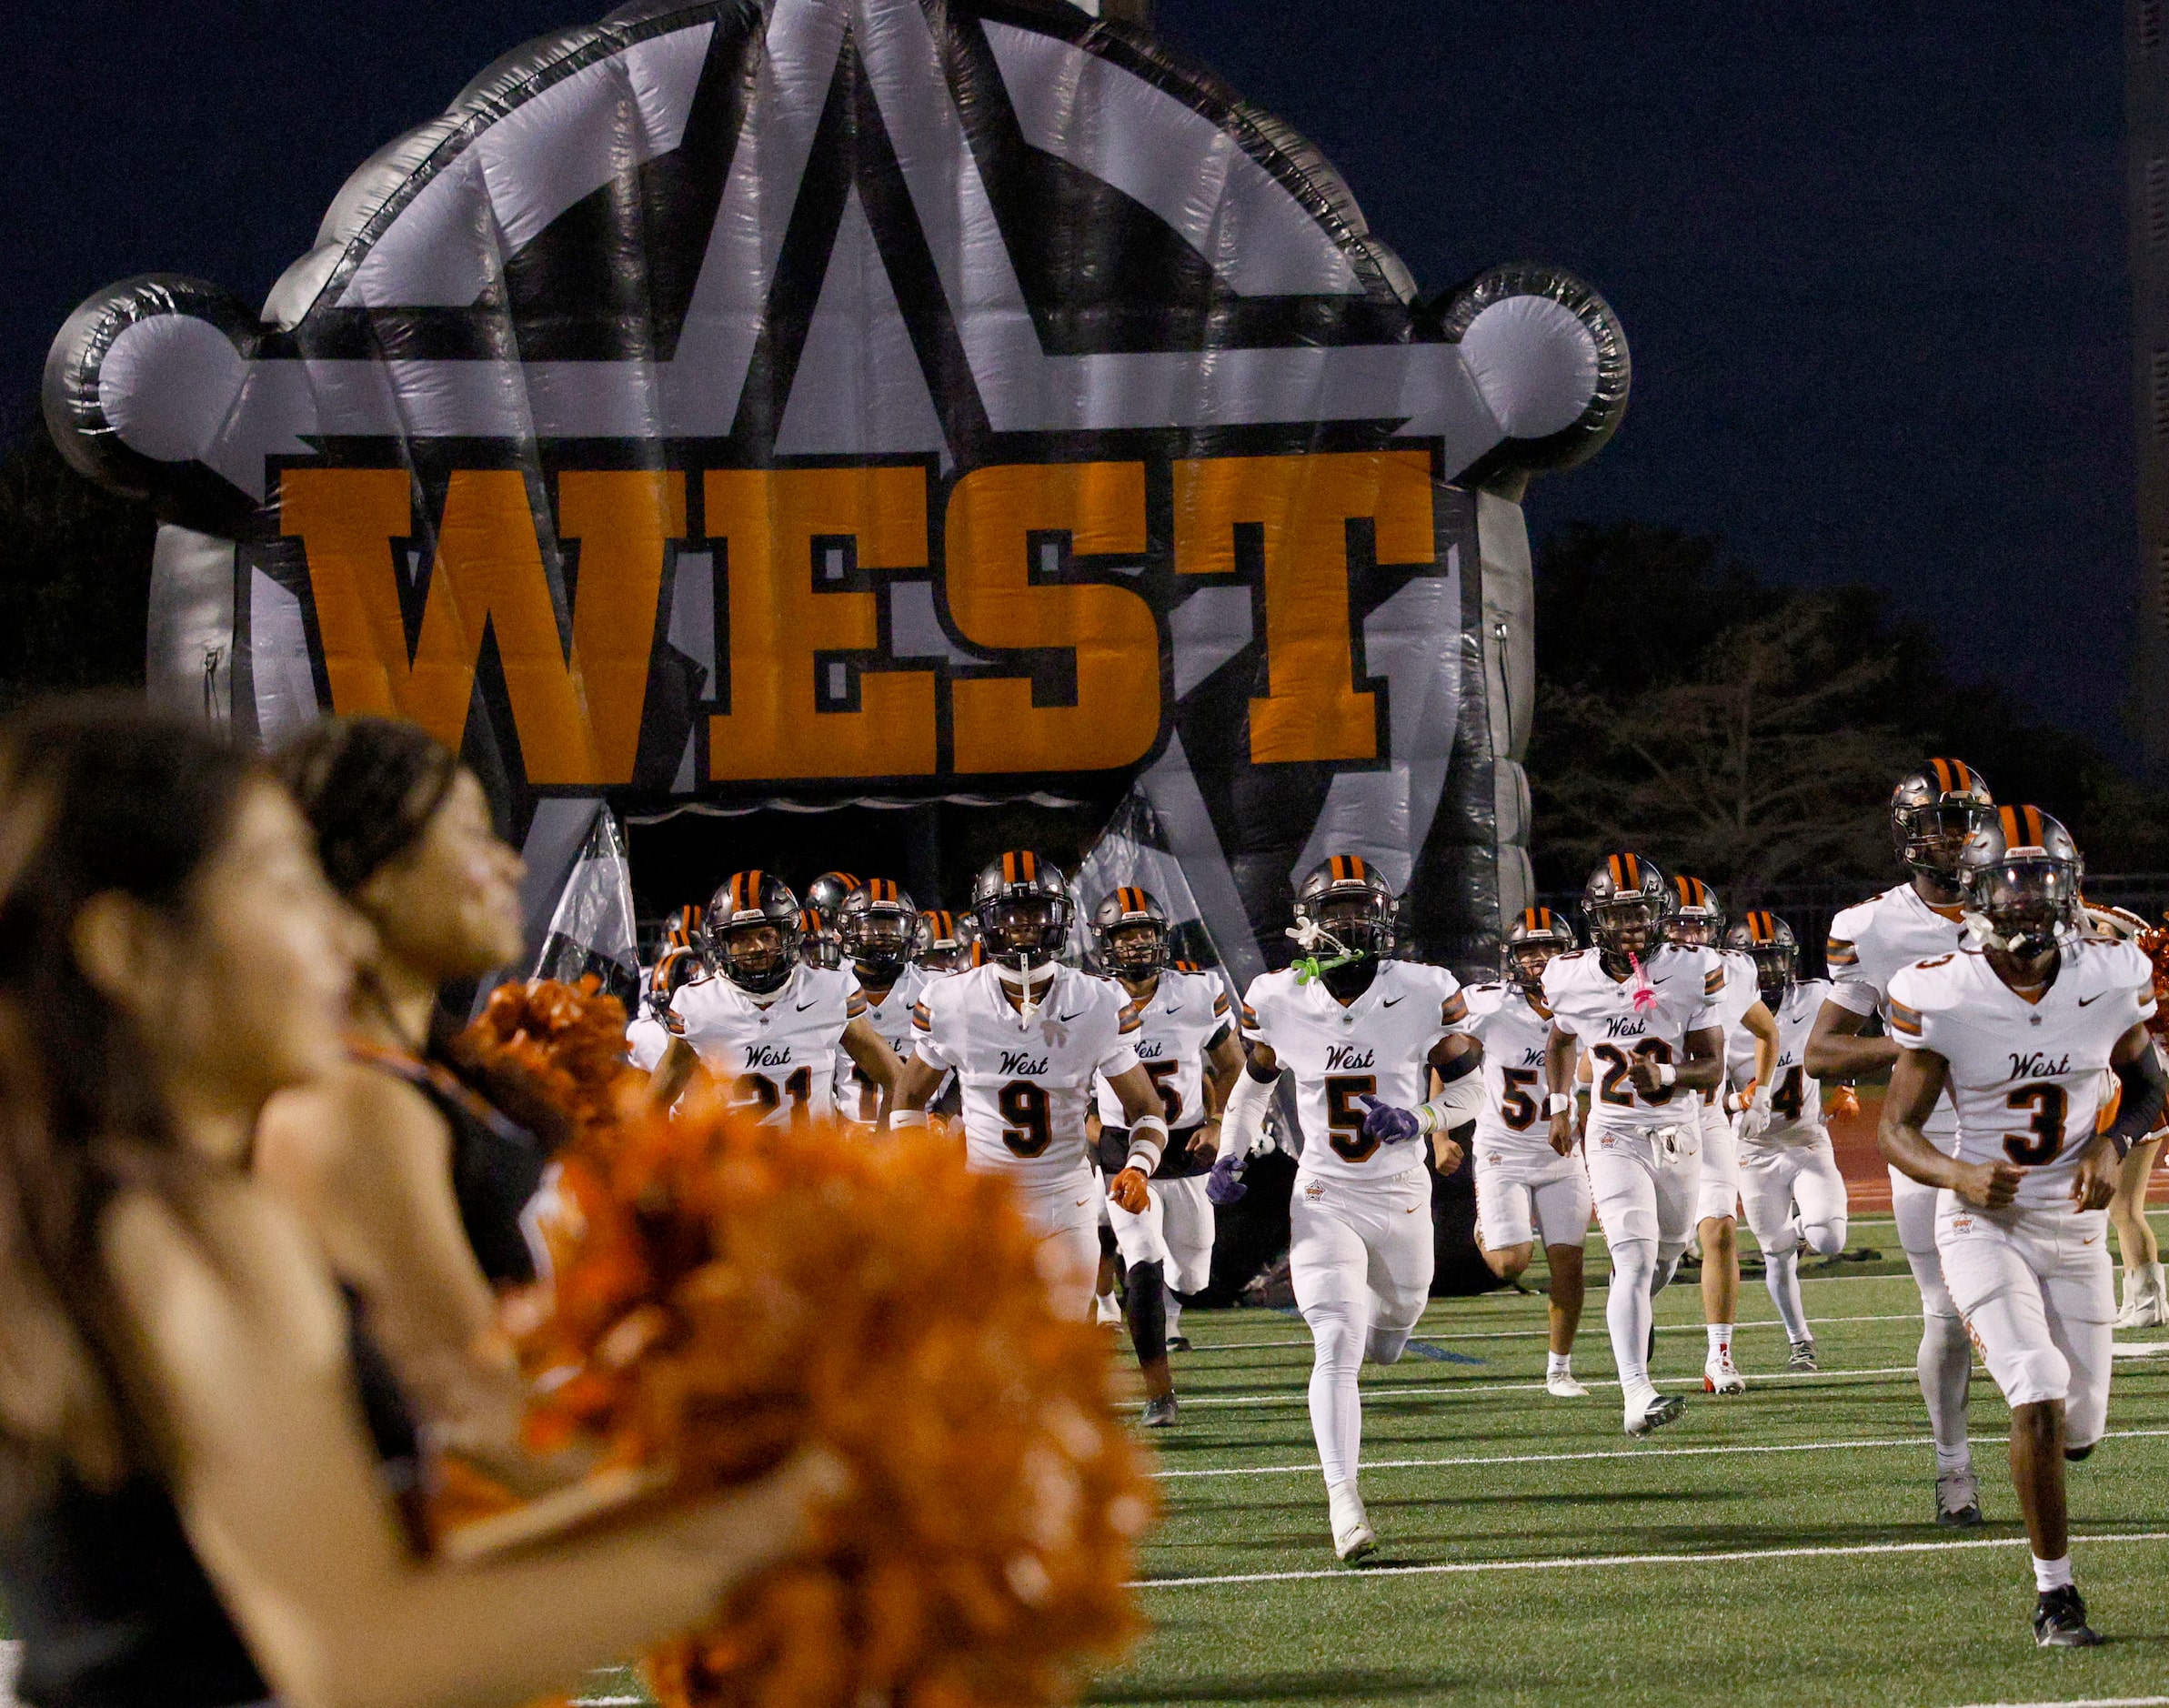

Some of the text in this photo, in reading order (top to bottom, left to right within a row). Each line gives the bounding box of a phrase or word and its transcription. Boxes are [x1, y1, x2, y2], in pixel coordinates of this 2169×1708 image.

[278, 449, 1436, 787] WEST
[1606, 1017, 1646, 1039] West
[746, 1046, 792, 1069] West
[999, 1051, 1049, 1075] West
[1325, 1046, 1375, 1071] West
[1521, 1048, 1546, 1067] We
[1593, 1037, 1677, 1108] 20
[1777, 1050, 1793, 1068] st
[2009, 1051, 2072, 1080] West
[733, 1065, 812, 1128] 21
[1122, 1059, 1183, 1128] 5
[998, 1080, 1053, 1160] 9
[1324, 1074, 1381, 1164] 5
[2002, 1081, 2068, 1167] 3
